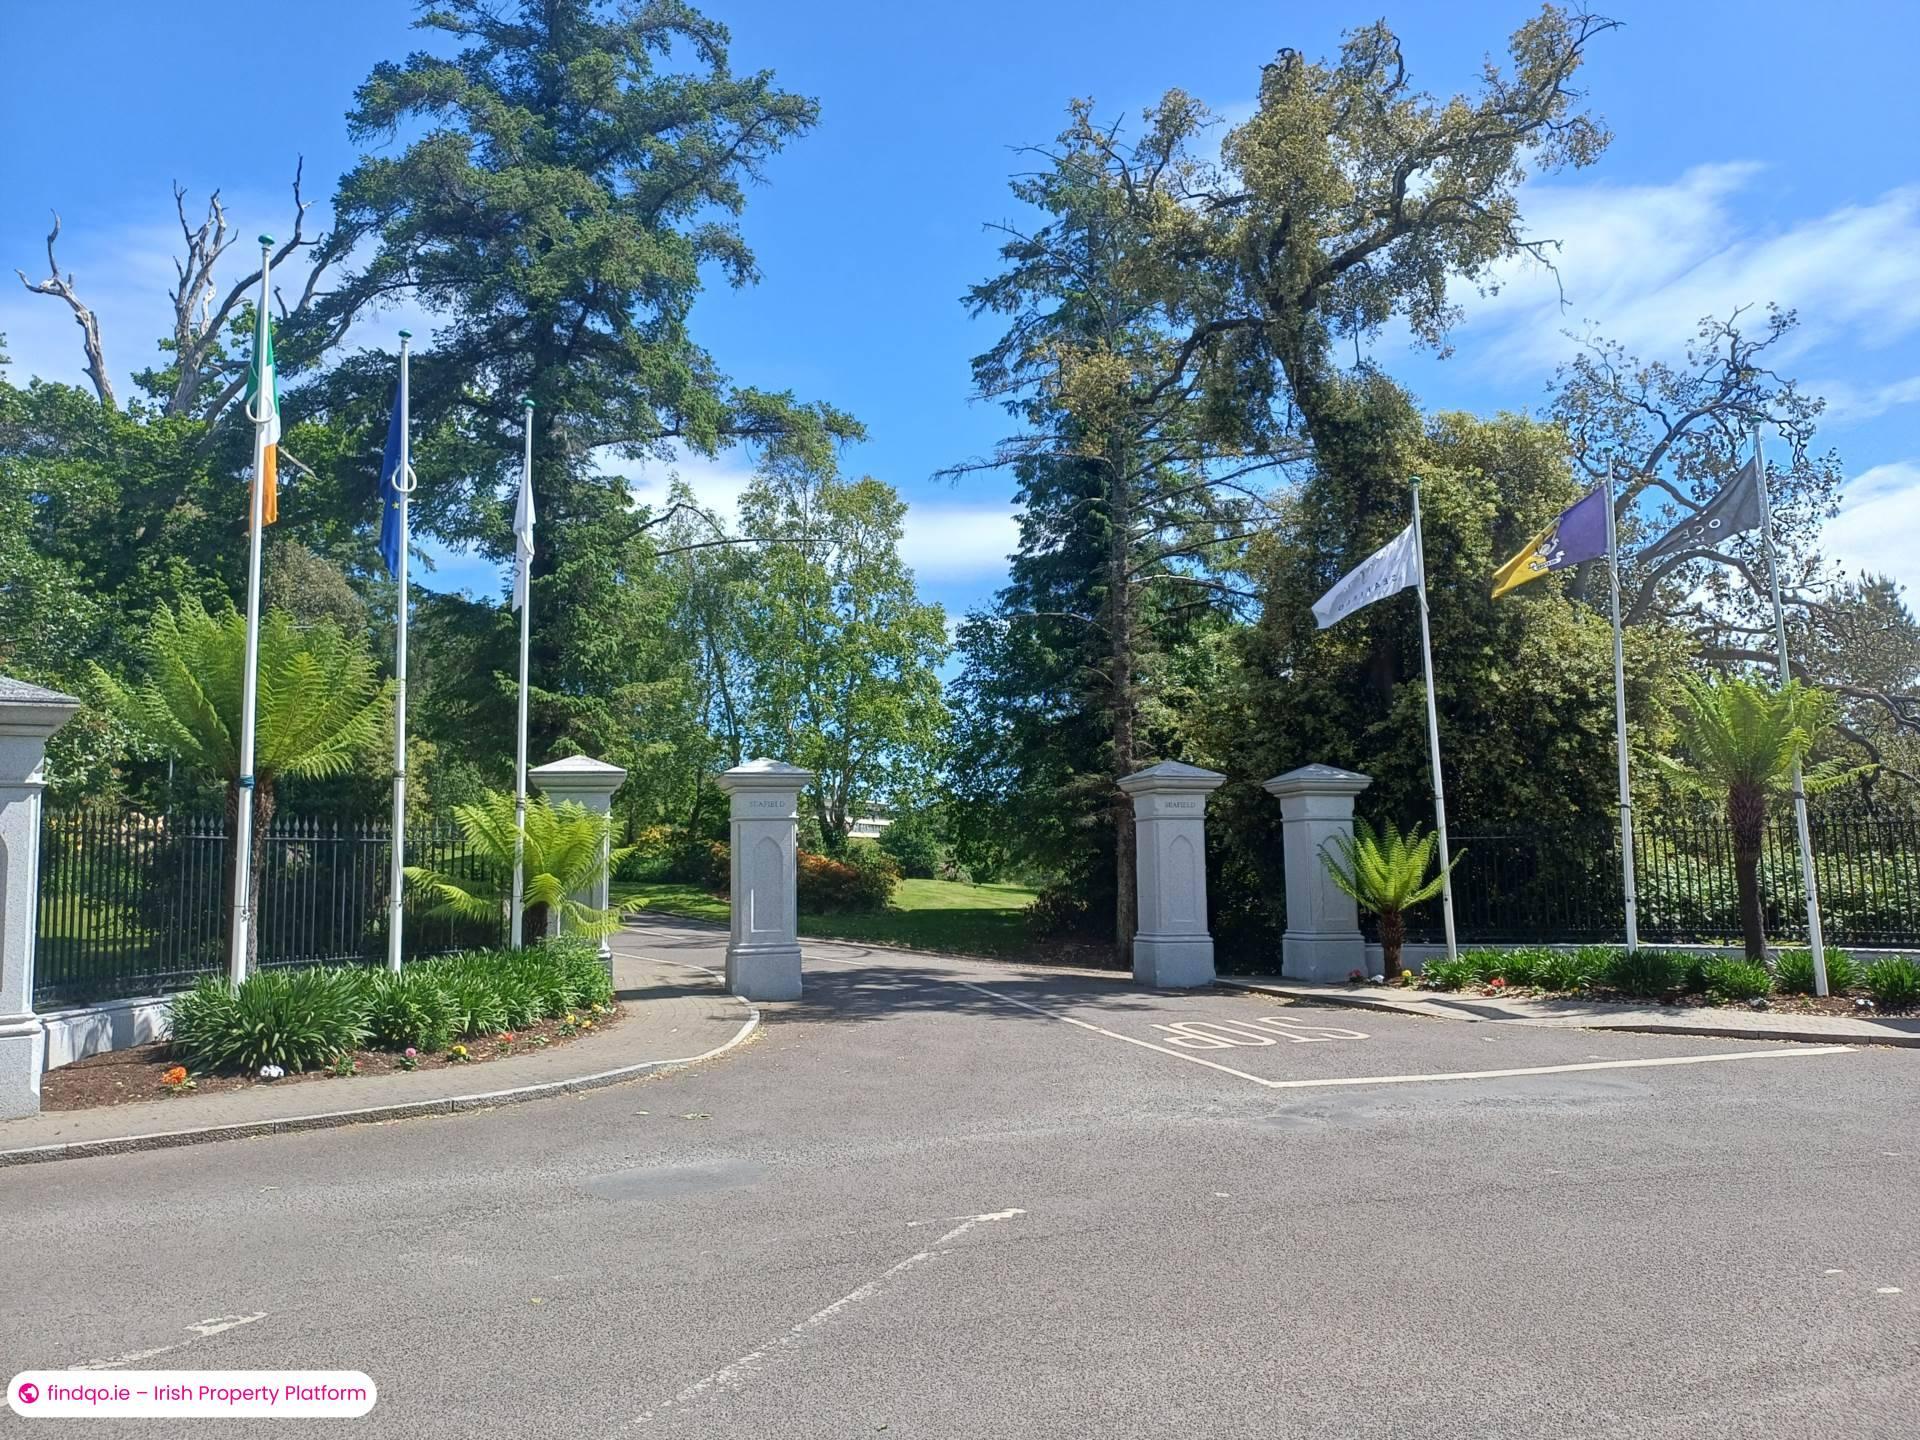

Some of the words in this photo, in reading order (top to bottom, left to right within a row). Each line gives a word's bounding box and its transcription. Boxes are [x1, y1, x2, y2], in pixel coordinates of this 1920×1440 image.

[749, 800, 786, 808] SEAFIELD
[1165, 801, 1196, 809] SEAFIELD
[1151, 1016, 1371, 1050] STOP
